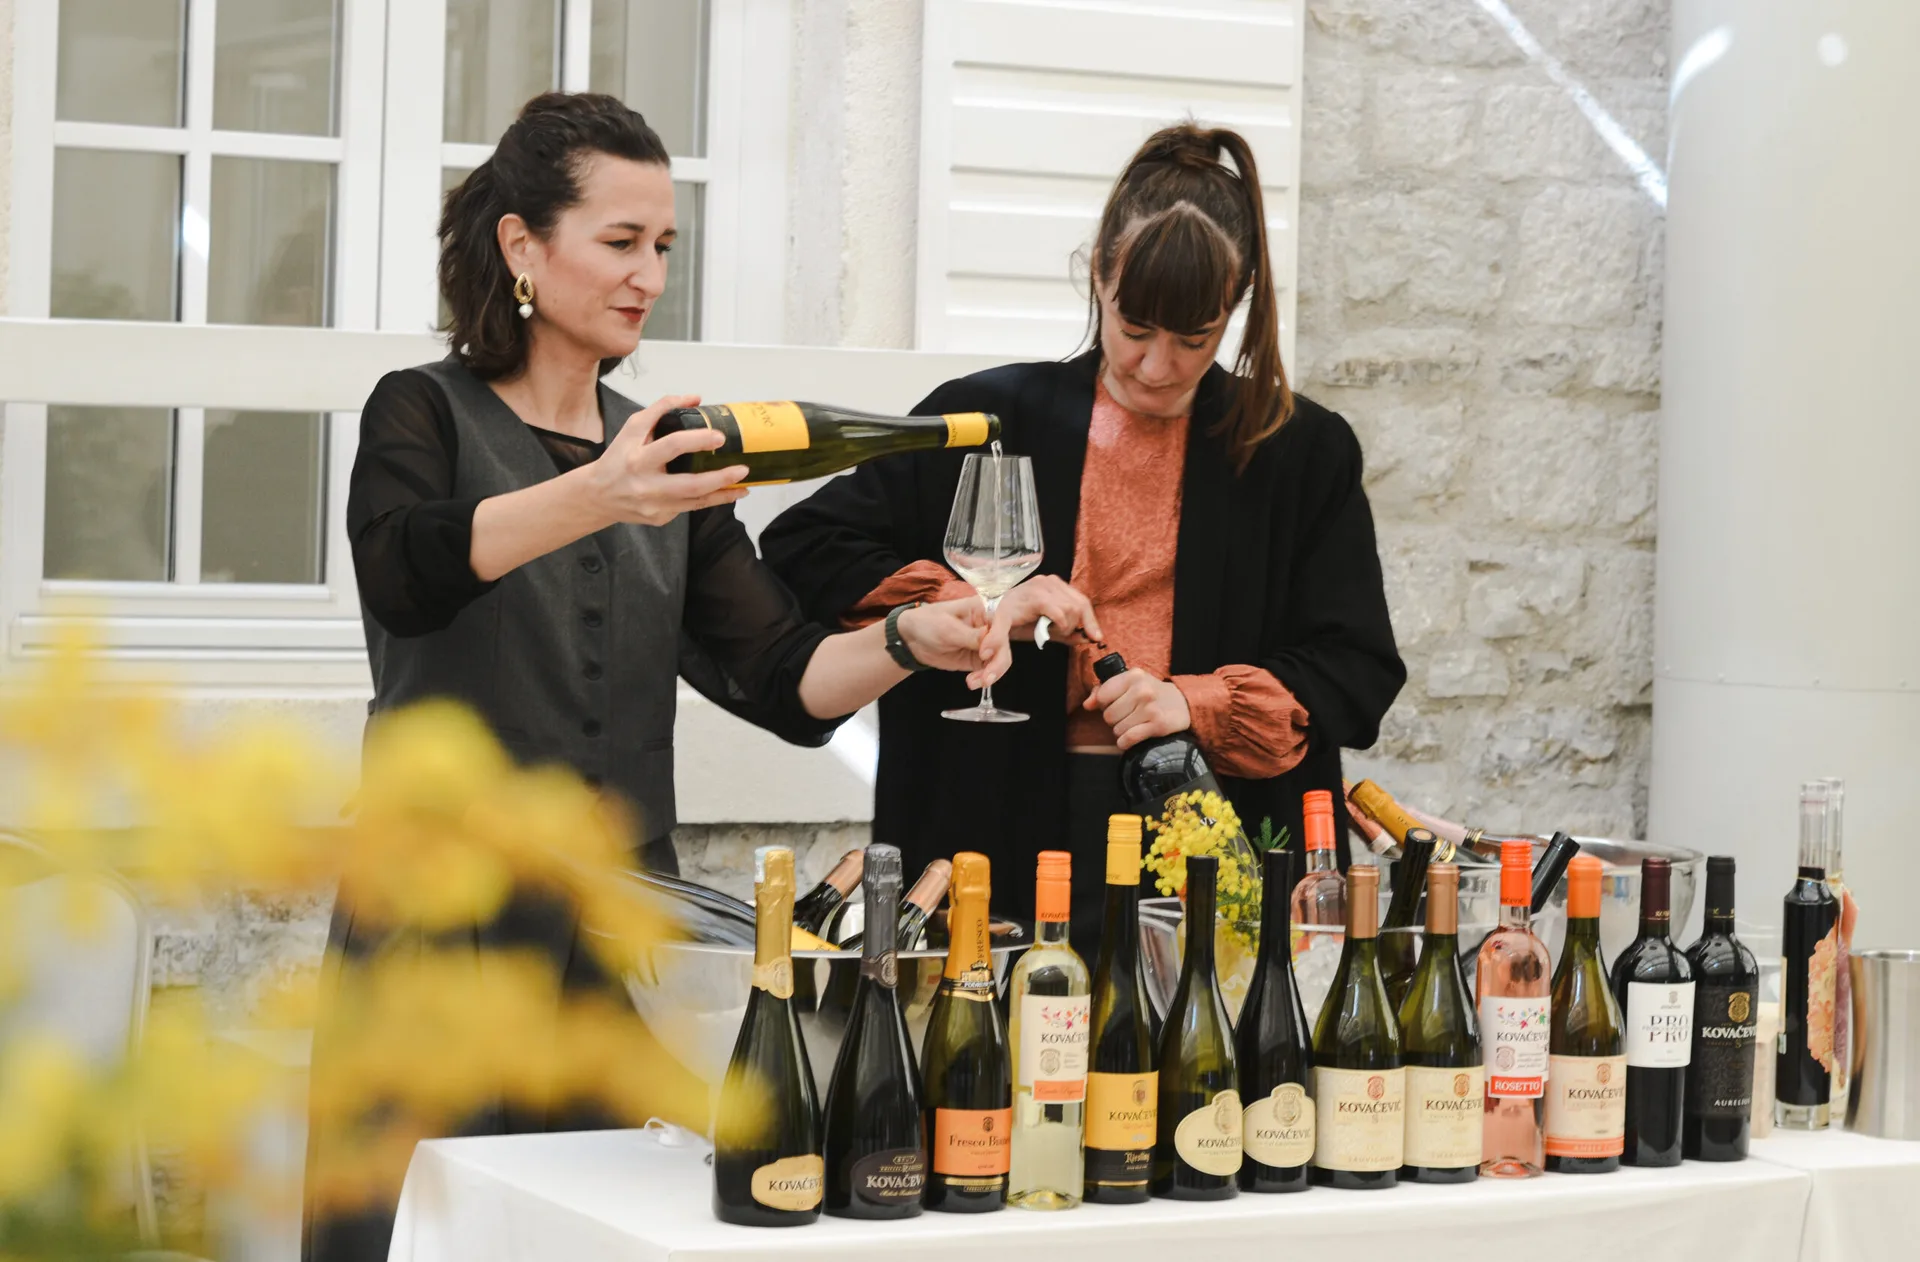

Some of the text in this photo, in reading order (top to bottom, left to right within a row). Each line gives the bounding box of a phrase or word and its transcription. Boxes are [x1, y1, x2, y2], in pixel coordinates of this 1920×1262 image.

[1494, 1081, 1541, 1091] ROSETTO
[1339, 1100, 1402, 1113] KOVAČEVIĆ
[949, 1134, 985, 1147] Fresco
